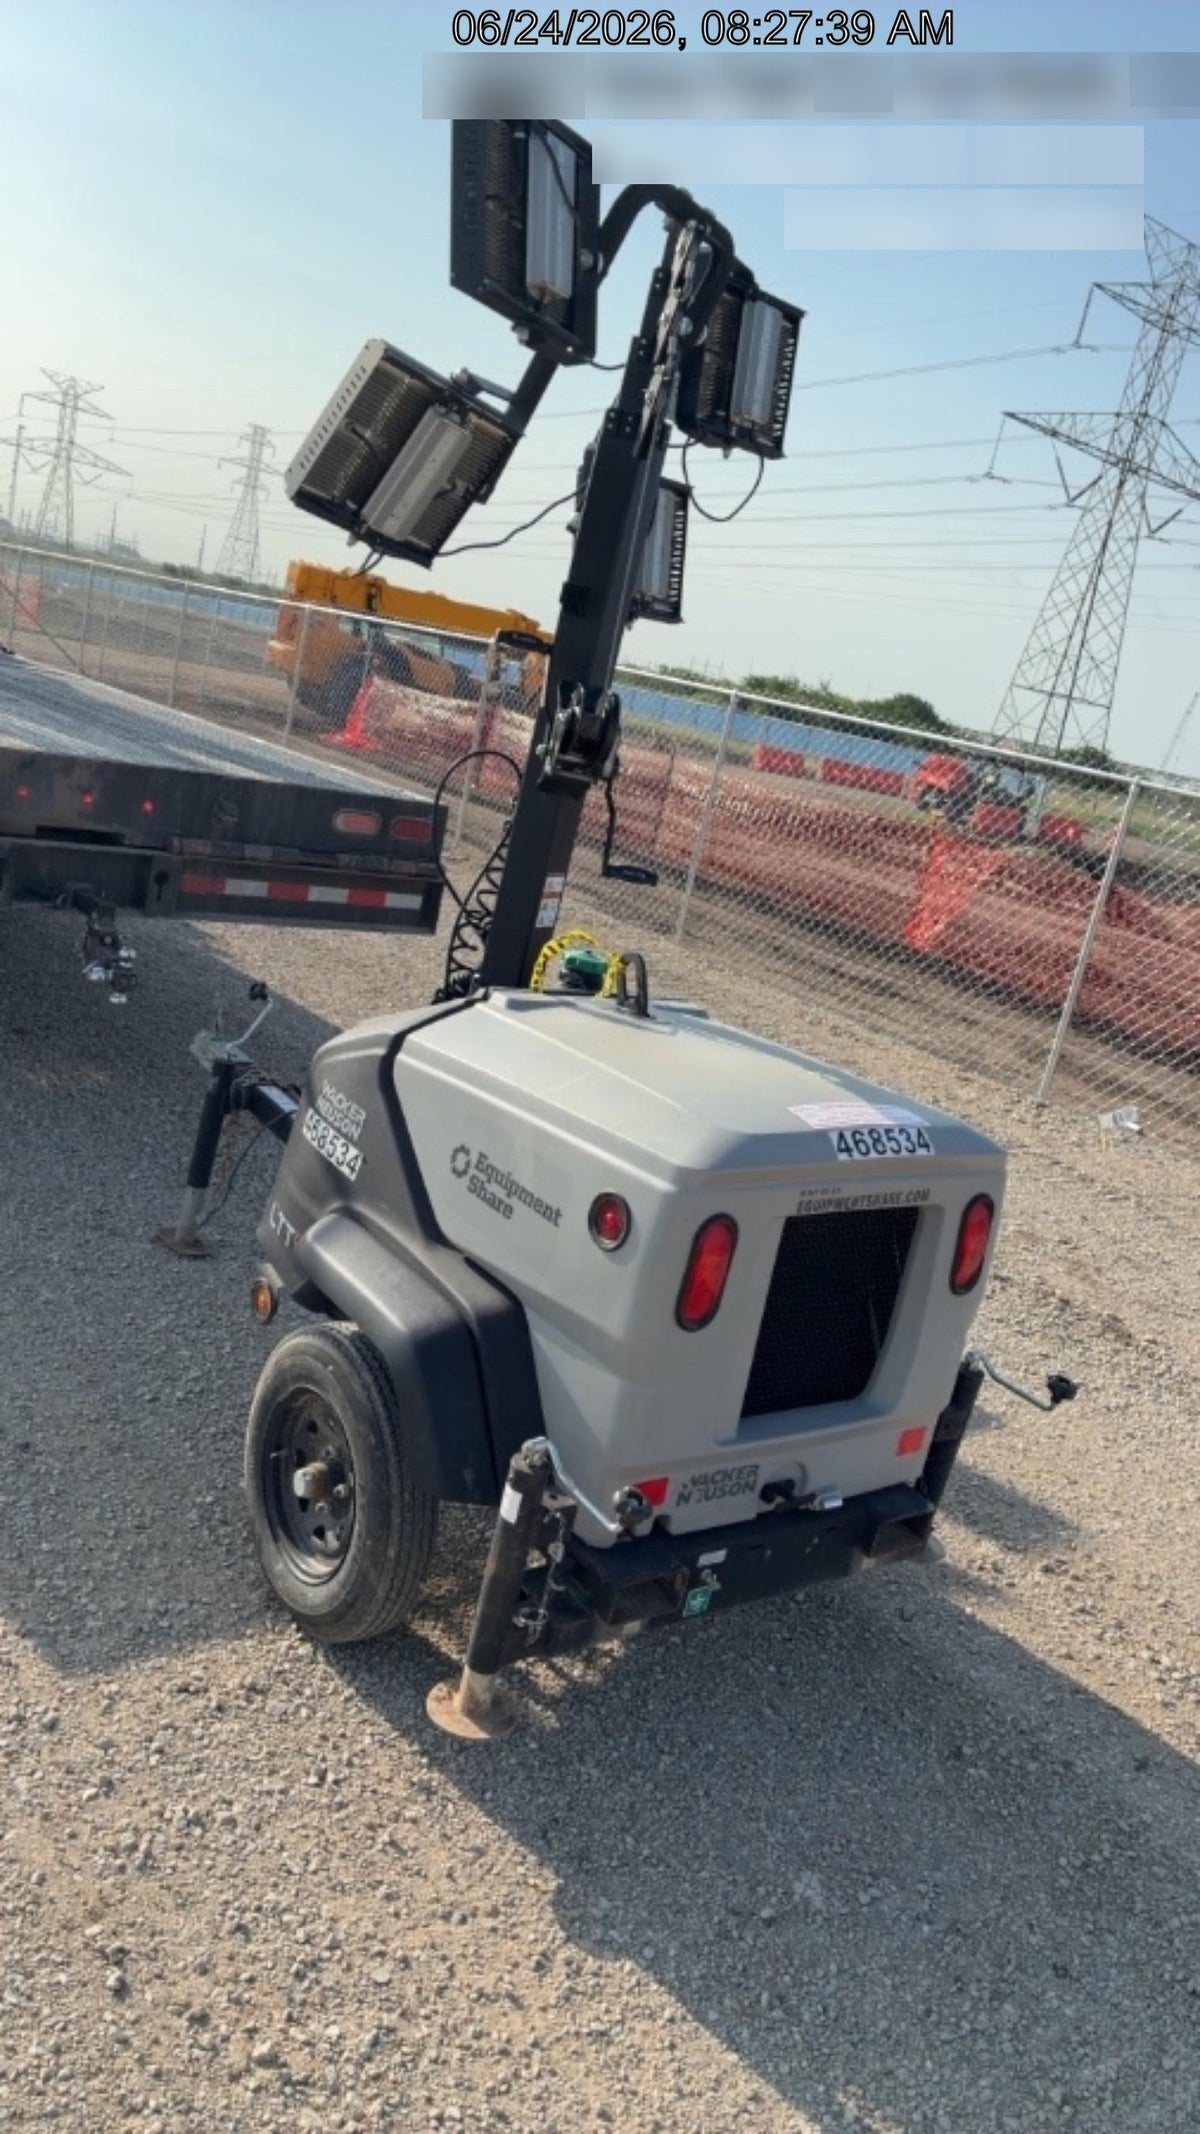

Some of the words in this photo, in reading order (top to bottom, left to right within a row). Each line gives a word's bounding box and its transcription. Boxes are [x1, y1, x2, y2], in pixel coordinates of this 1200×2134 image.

[836, 1128, 931, 1157] 468534
[467, 1174, 514, 1220] Share
[474, 1151, 563, 1227] Equipment
